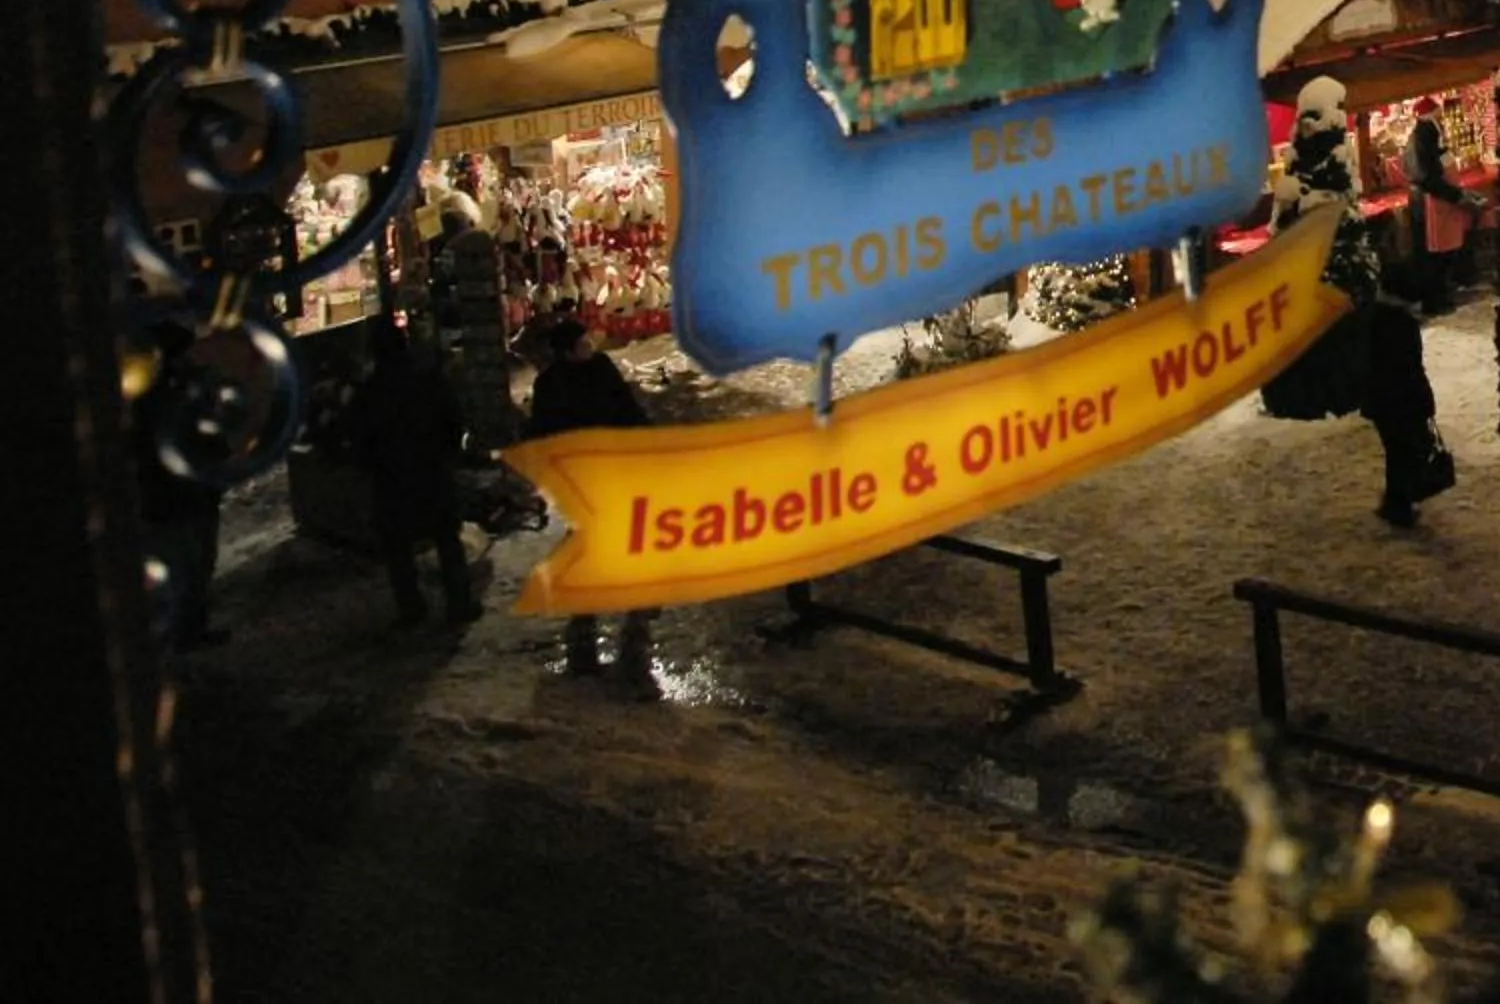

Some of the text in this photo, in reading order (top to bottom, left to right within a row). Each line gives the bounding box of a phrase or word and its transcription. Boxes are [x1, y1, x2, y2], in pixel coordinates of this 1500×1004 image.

[762, 141, 1231, 310] TROIS CHATEAUX
[970, 116, 1054, 172] DES
[627, 283, 1290, 556] Isabelle & Olivier WOLFF
